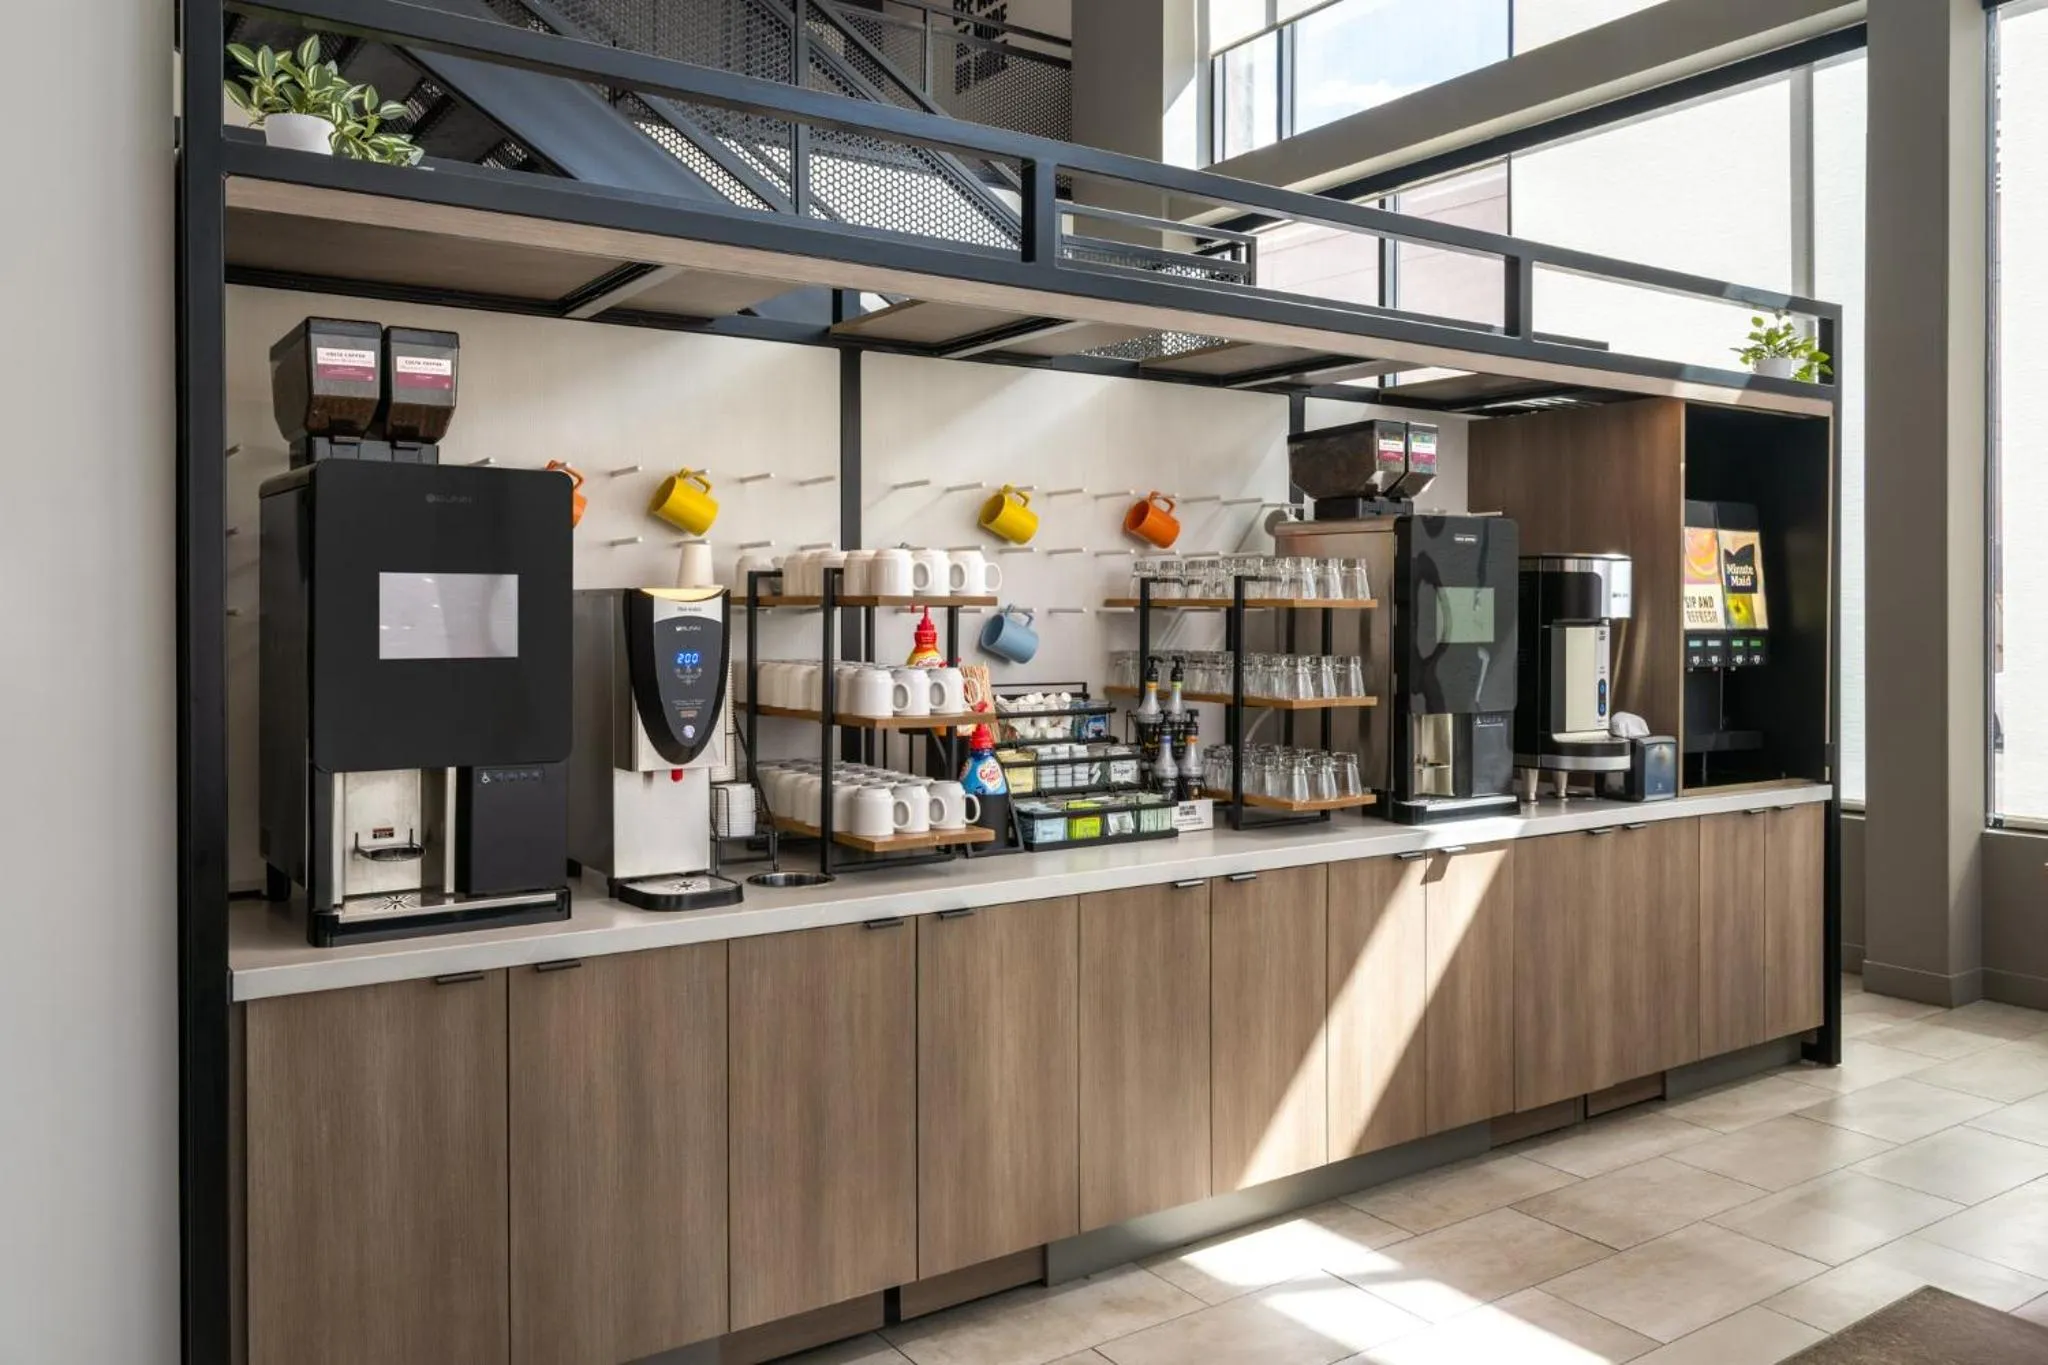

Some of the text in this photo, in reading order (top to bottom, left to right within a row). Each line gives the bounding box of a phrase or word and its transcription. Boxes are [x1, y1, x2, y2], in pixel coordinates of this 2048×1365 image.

[1726, 563, 1754, 575] Minute
[1730, 575, 1752, 586] Maid
[1698, 595, 1714, 608] AND
[677, 653, 699, 664] 200
